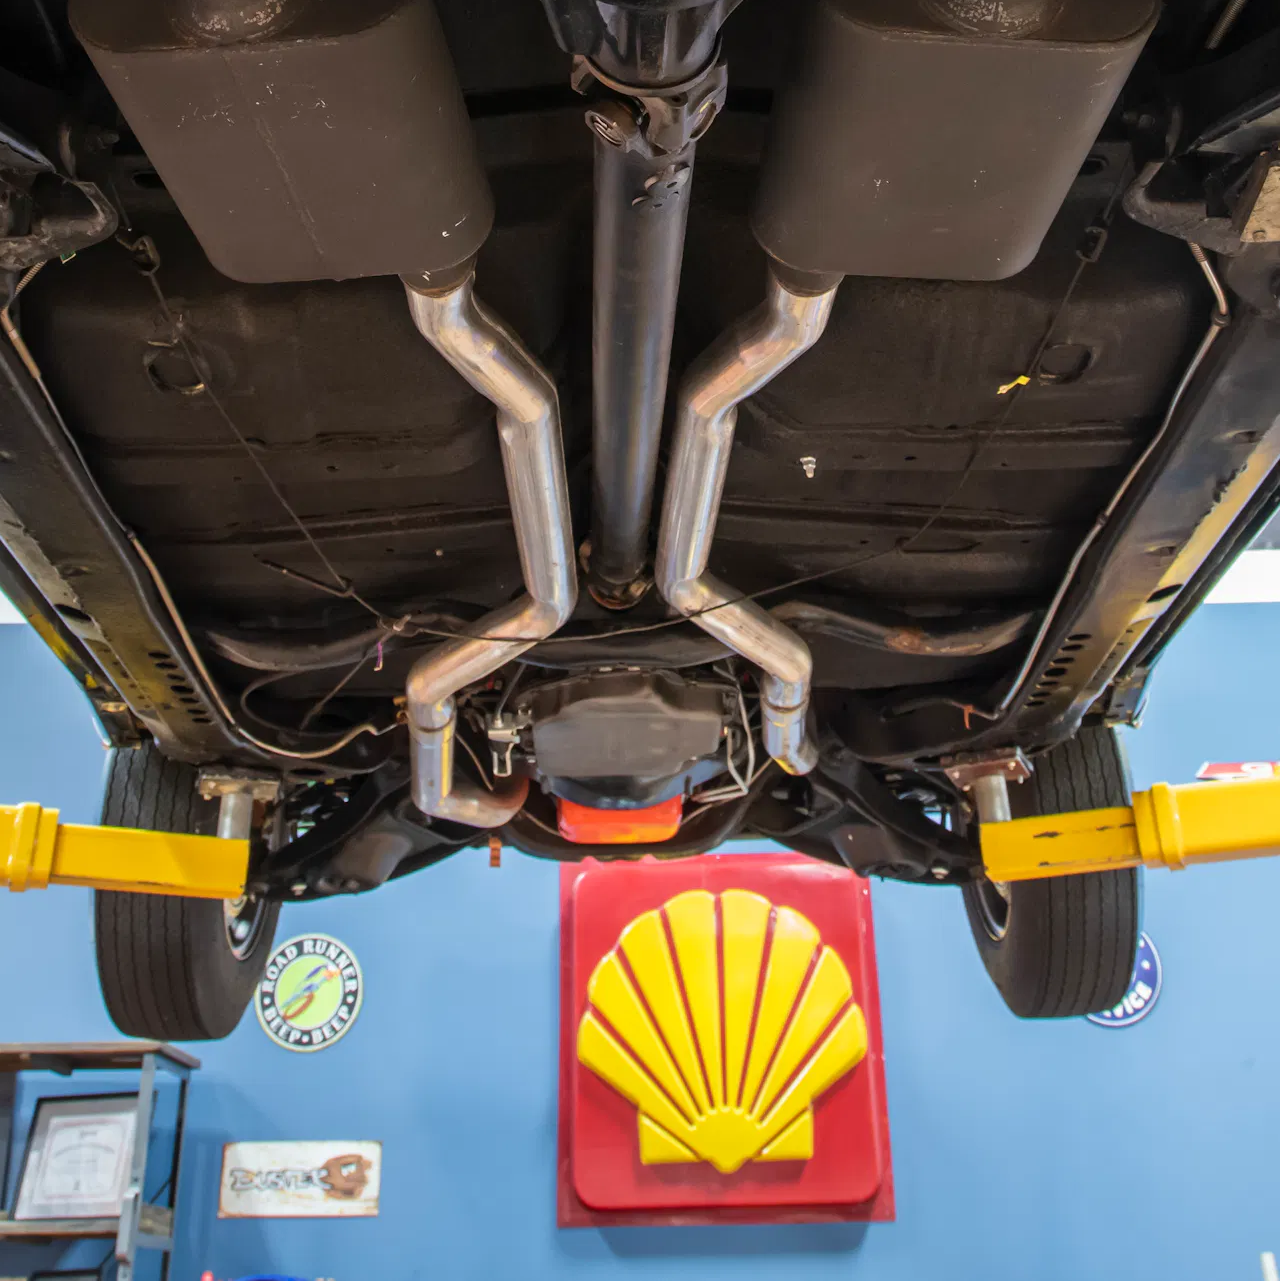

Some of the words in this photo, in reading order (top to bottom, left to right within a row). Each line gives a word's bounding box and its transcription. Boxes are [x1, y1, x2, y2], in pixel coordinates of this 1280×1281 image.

[262, 944, 298, 993] ROAD
[303, 939, 358, 993] RUNNER
[263, 1006, 301, 1043] BEEP
[311, 1005, 351, 1044] BEEP
